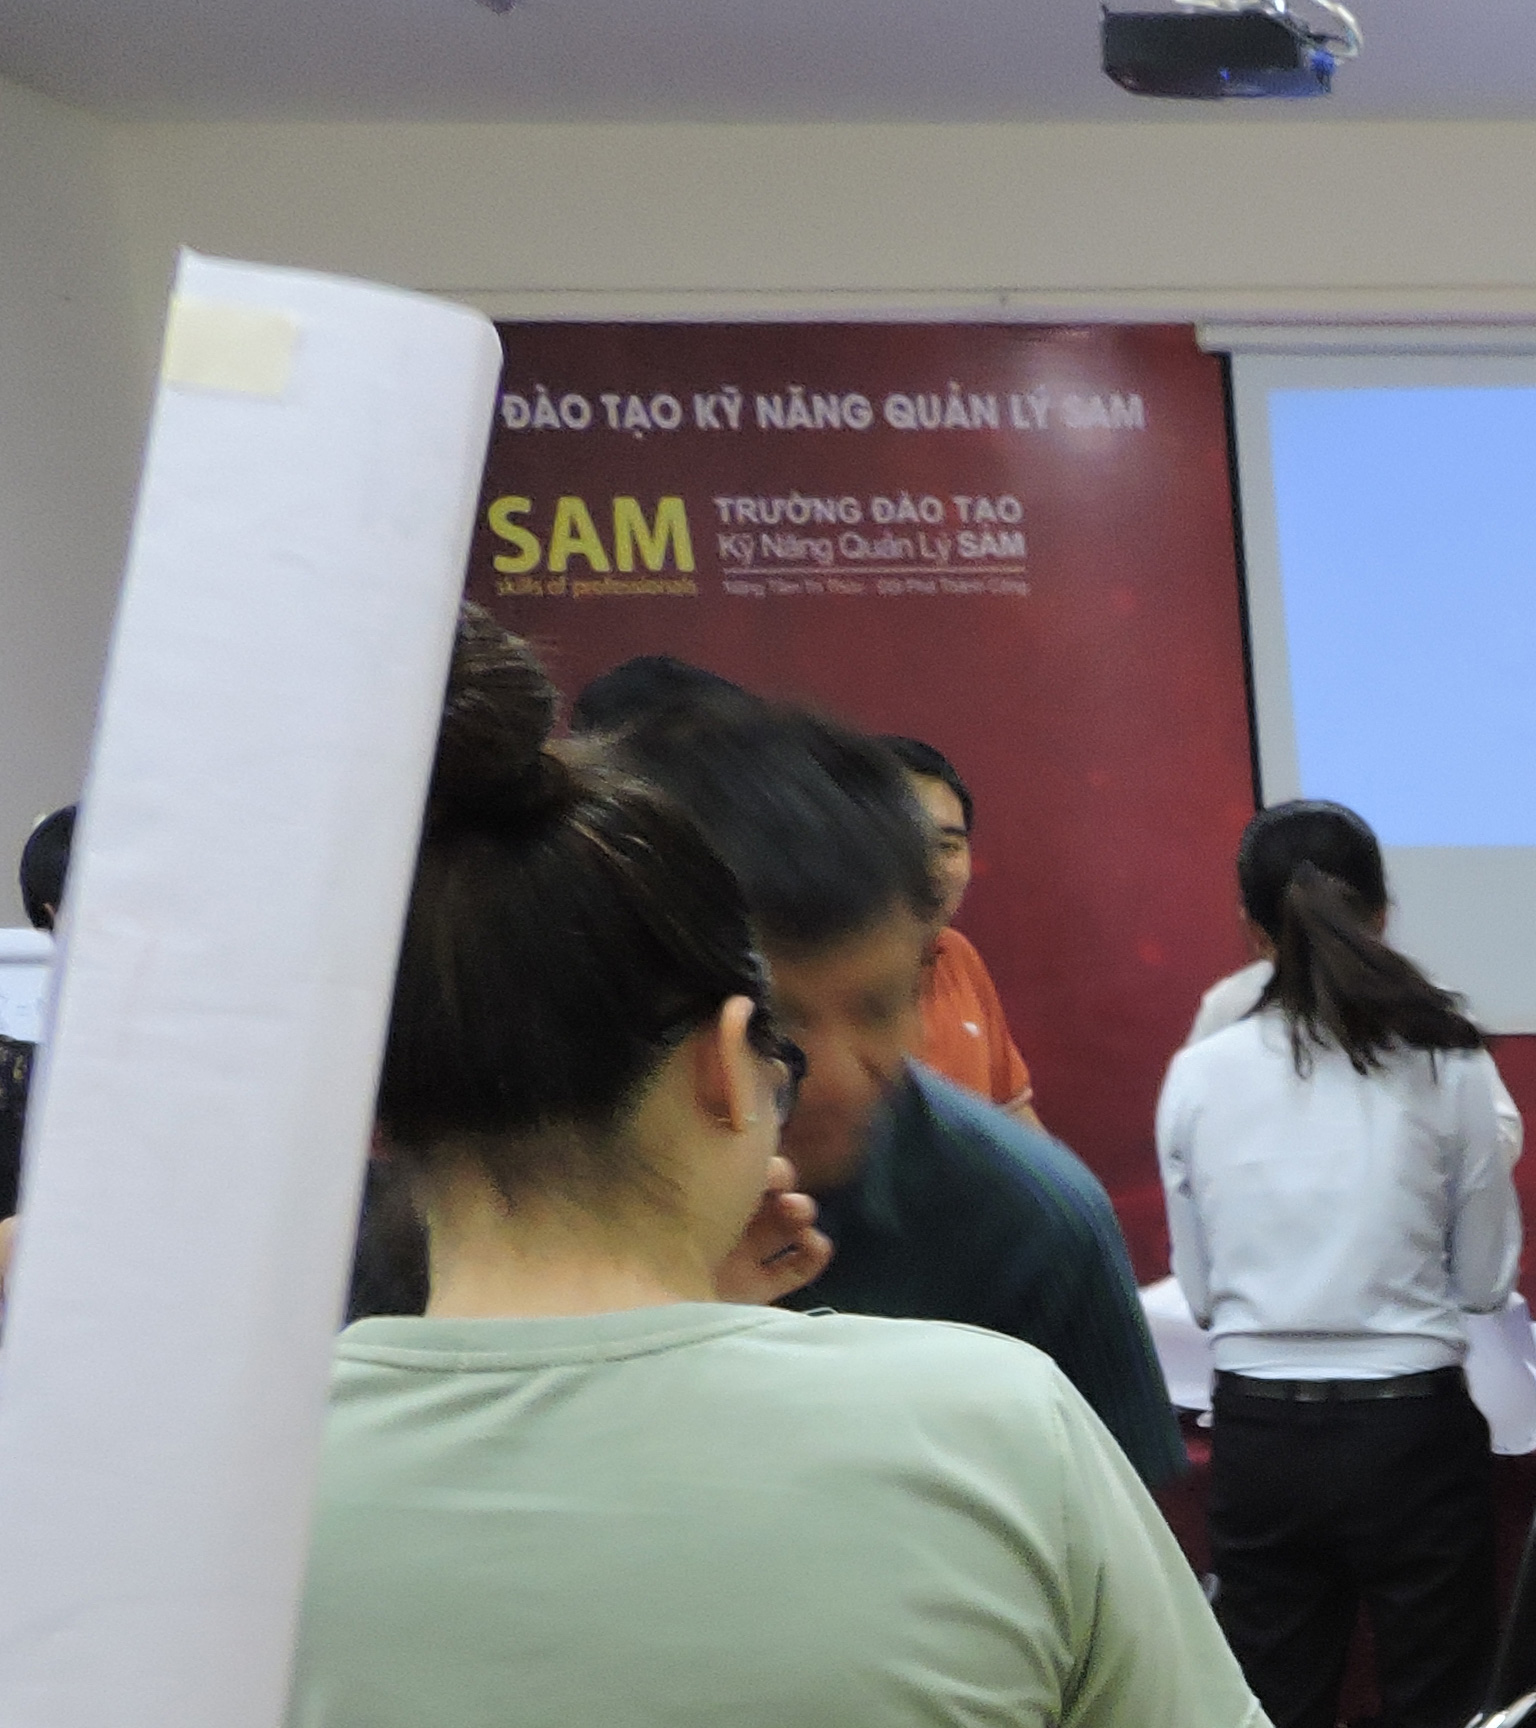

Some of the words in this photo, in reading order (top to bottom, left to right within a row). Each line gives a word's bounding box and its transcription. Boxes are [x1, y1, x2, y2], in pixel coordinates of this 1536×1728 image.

[601, 394, 683, 439] TẠO
[755, 384, 874, 429] NĂNG
[884, 381, 1000, 430] QUẢN
[487, 495, 696, 574] SAM
[956, 530, 1026, 559] SAM
